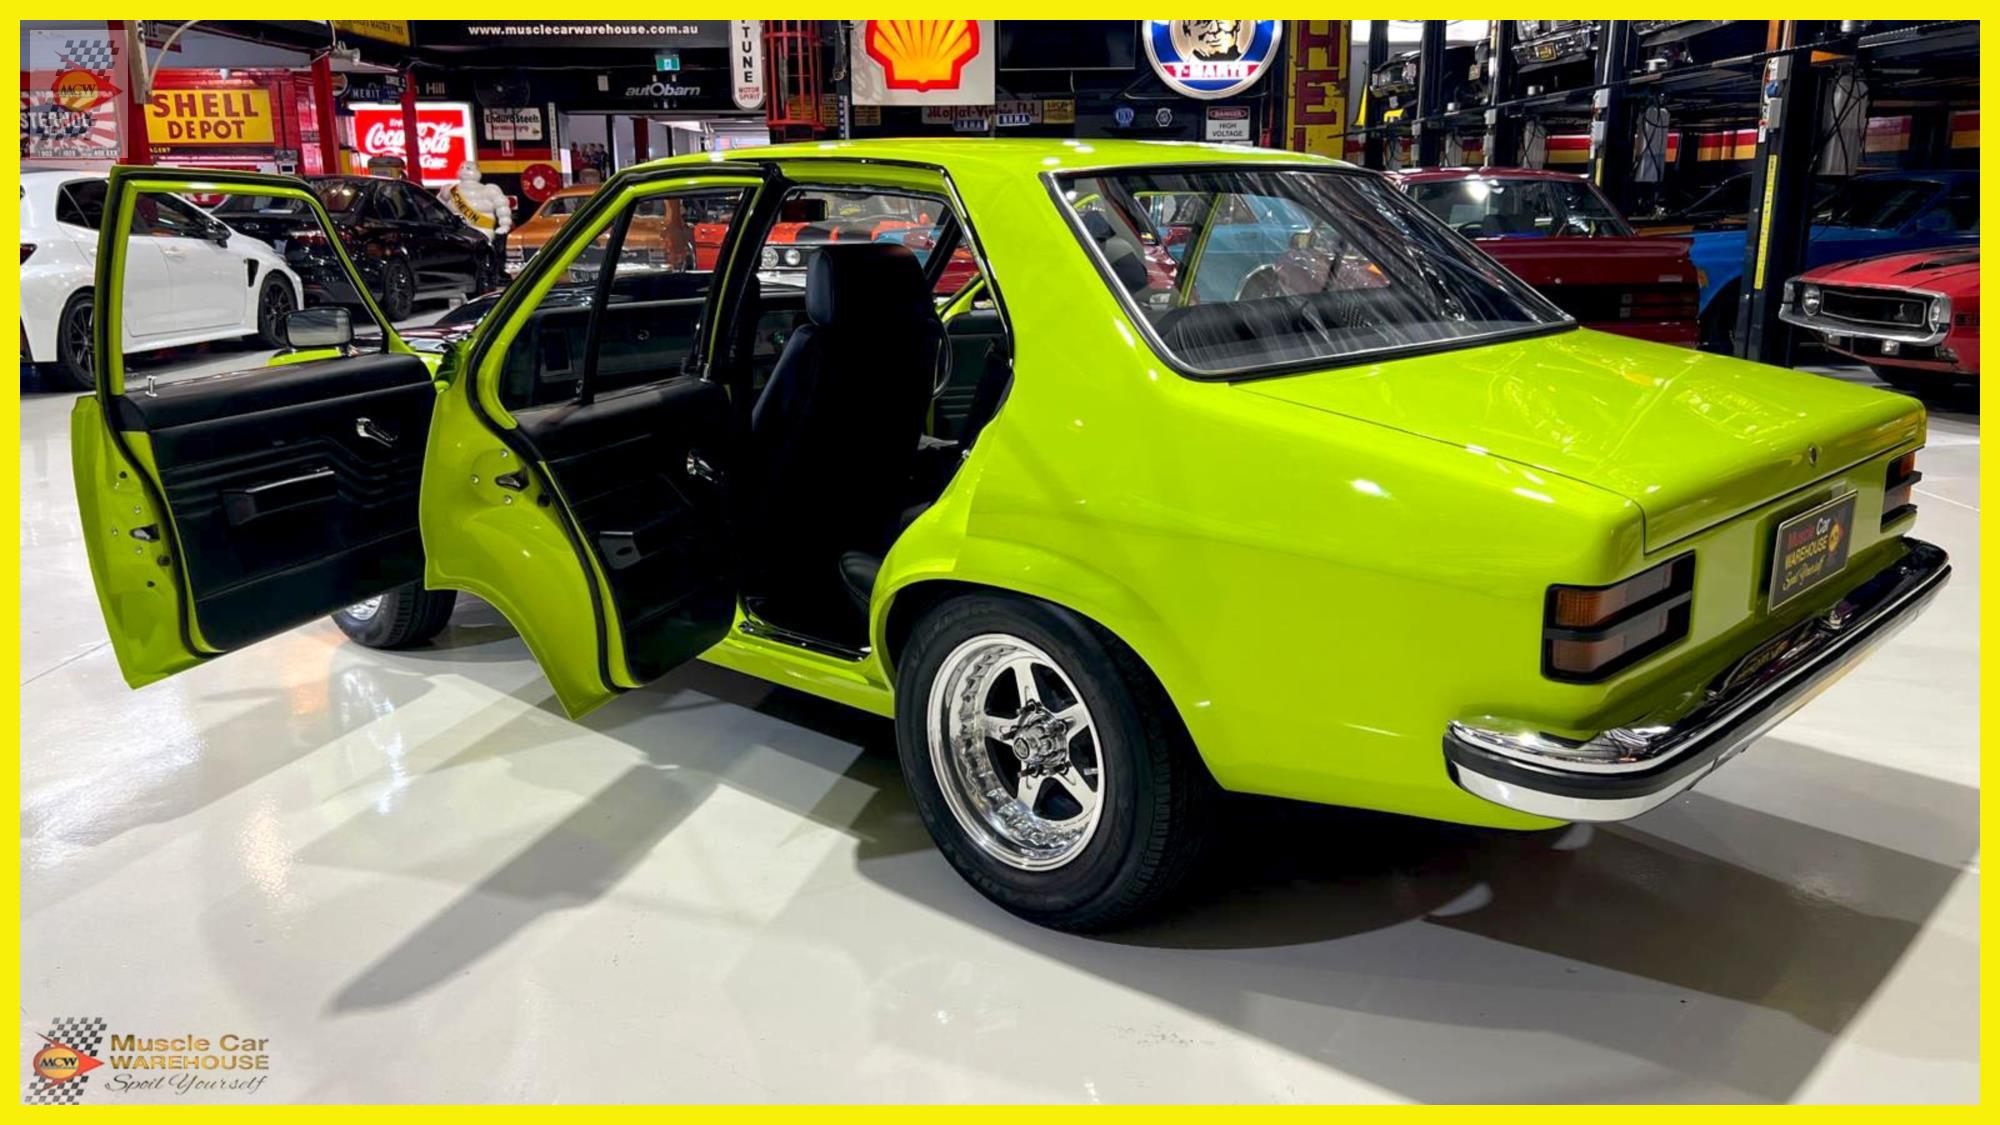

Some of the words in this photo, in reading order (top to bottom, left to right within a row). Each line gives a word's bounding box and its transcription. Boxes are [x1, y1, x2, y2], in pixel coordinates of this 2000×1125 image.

[468, 24, 698, 35] www.musclecarwarehouse.com.au
[741, 20, 753, 83] TUNE
[153, 93, 259, 118] SHELL
[167, 120, 245, 139] DEPOT
[1816, 517, 1831, 535] Car
[1785, 534, 1829, 570] WAREHOUSE
